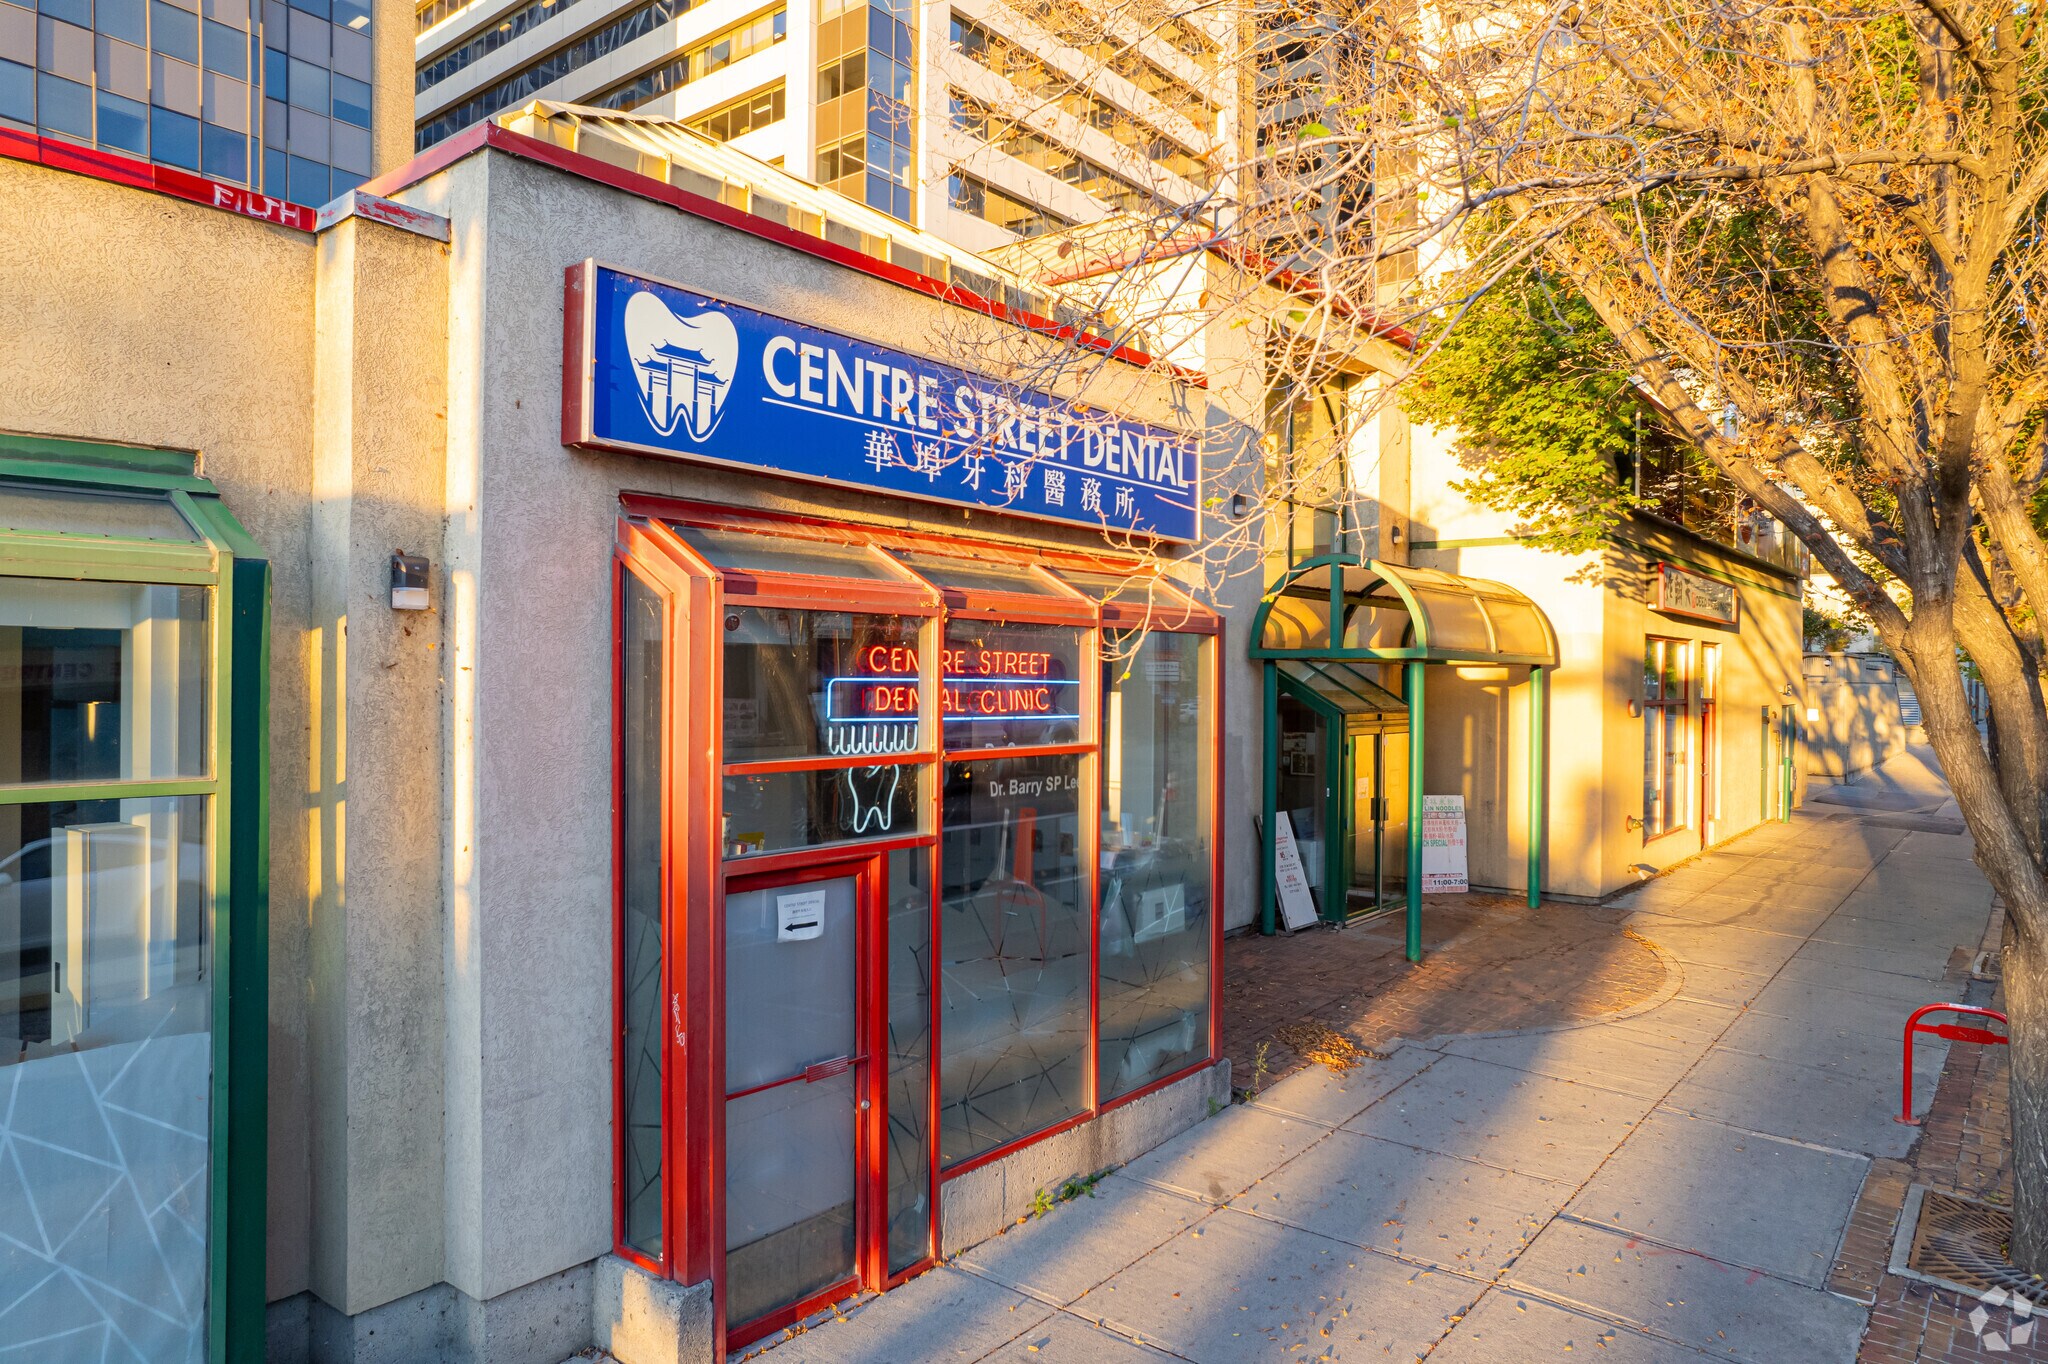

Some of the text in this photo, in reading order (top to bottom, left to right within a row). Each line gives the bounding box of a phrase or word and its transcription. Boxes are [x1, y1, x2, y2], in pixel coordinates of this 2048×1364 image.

[213, 184, 300, 227] FILTH
[762, 335, 1189, 488] CENTRE STREET DENTAL
[863, 429, 1135, 519] 華埠牙科醫務所
[868, 645, 1051, 675] CENRE STREET
[874, 686, 1049, 713] DENAL CLINIC
[989, 780, 1006, 798] Dr.
[1009, 778, 1043, 797] Barry
[1046, 775, 1062, 792] SP
[1433, 878, 1468, 886] 11:00-7:00
